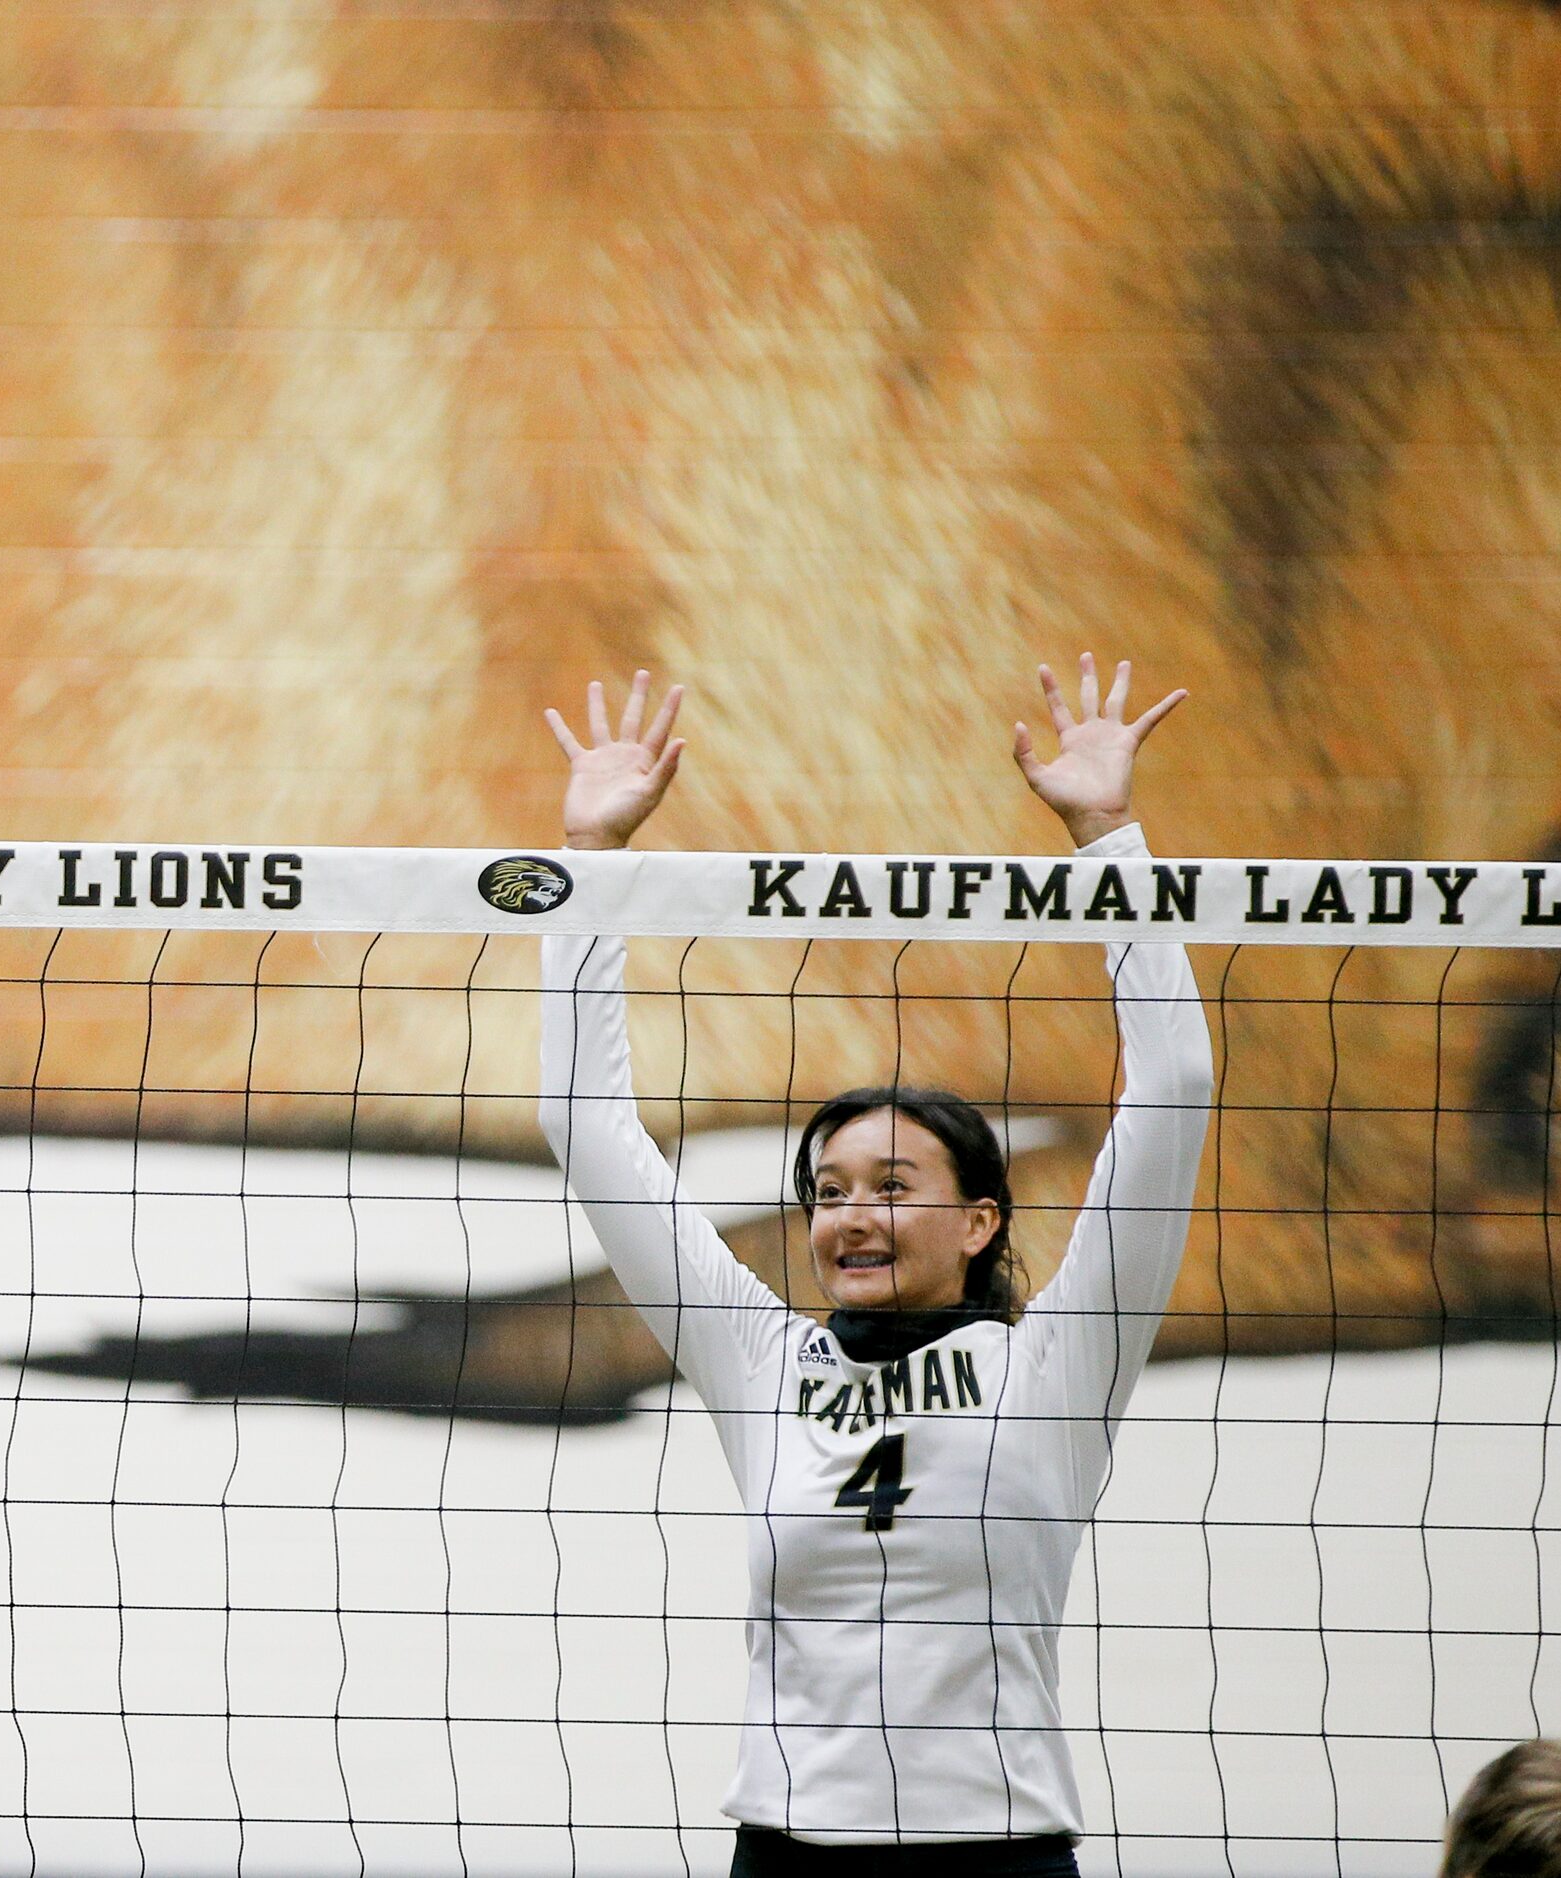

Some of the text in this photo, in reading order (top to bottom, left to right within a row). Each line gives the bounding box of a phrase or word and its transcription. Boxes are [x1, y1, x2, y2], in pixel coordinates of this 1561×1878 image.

[58, 849, 303, 910] LIONS
[746, 859, 1203, 922] KAUFMAN
[1244, 865, 1478, 924] LADY
[797, 1349, 838, 1367] adidas
[831, 1432, 916, 1532] 4
